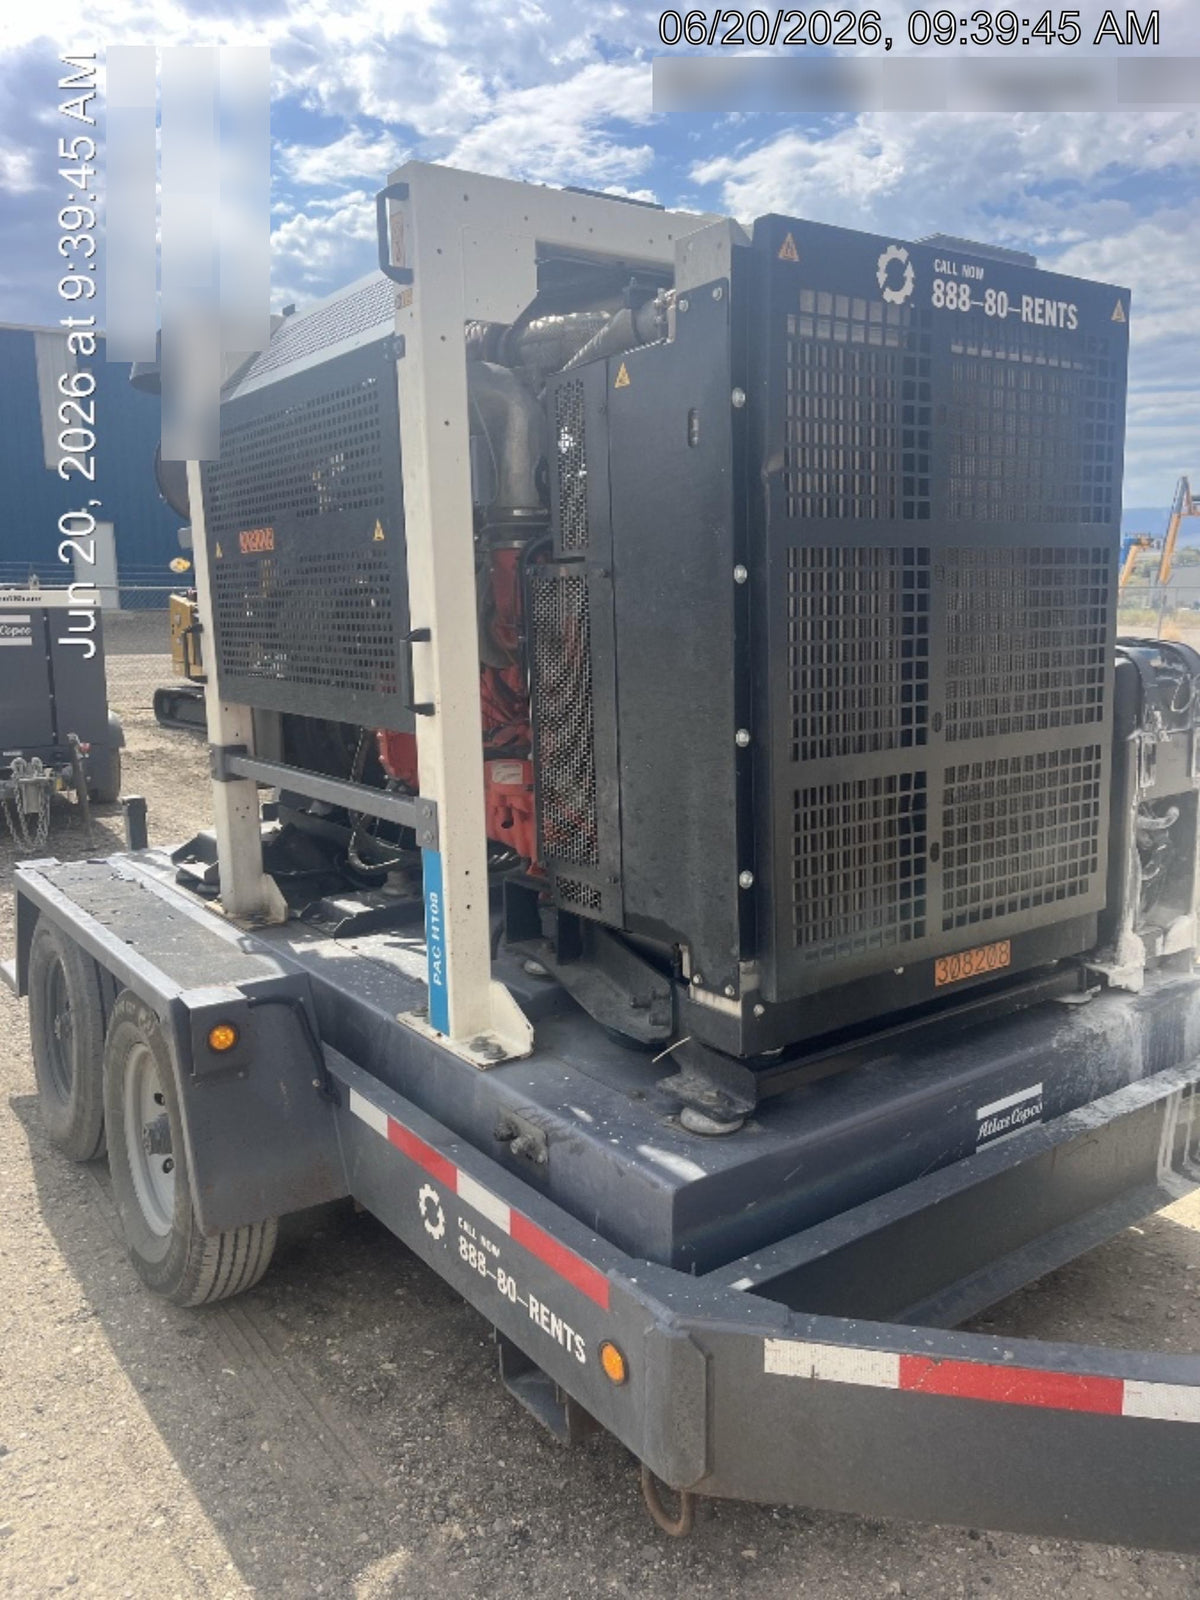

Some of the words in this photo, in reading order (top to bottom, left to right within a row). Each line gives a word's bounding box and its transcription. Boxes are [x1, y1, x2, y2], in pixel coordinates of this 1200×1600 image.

[934, 258, 957, 276] CALL
[962, 264, 985, 280] NOW
[932, 278, 1079, 330] 888-80-RENTS
[432, 945, 442, 986] PAC
[937, 940, 1010, 984] 308208
[976, 1113, 1010, 1141] Atlas
[1011, 1101, 1043, 1125] Copco
[458, 1217, 477, 1240] CALL
[481, 1235, 500, 1258] NOW
[459, 1235, 587, 1364] 888-80-RENTS
